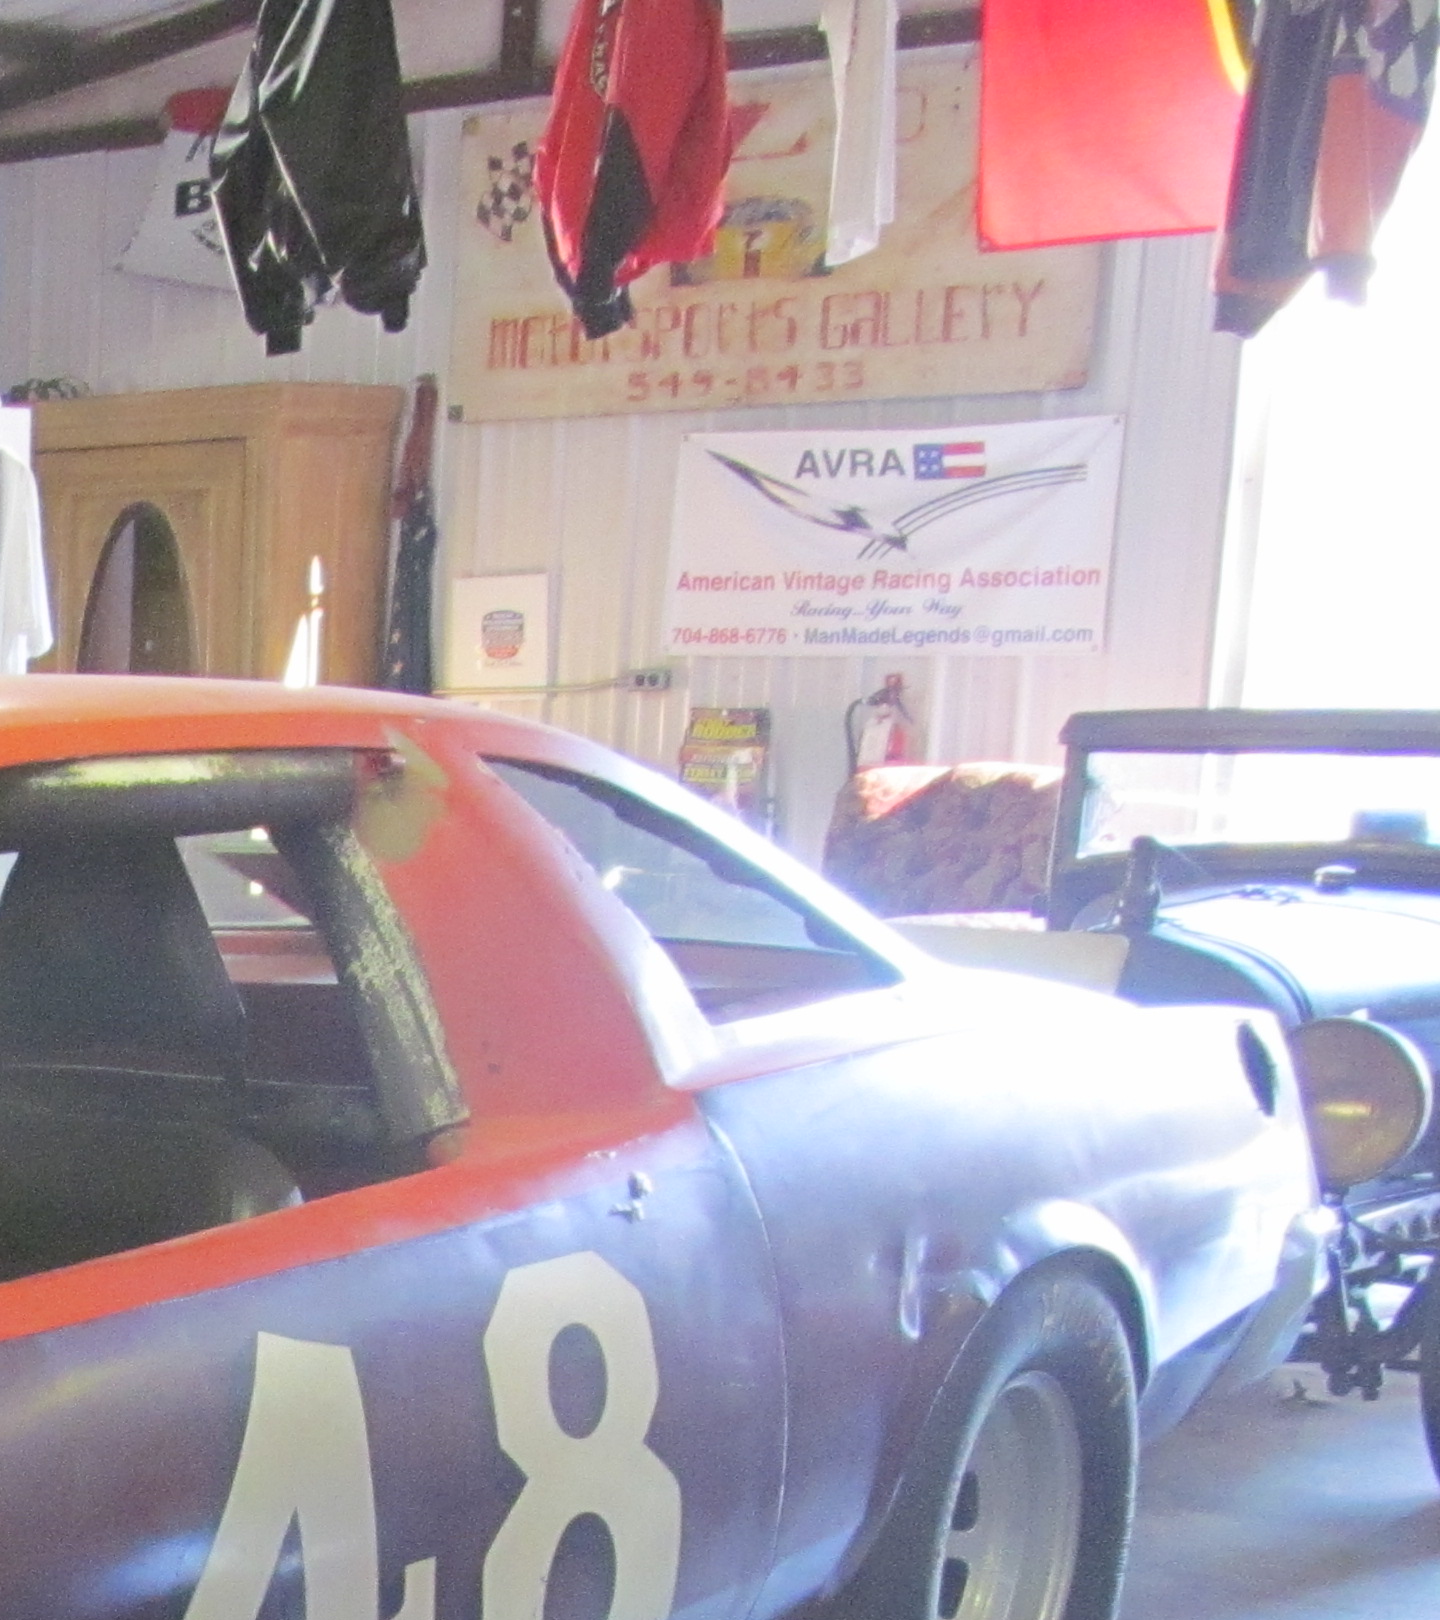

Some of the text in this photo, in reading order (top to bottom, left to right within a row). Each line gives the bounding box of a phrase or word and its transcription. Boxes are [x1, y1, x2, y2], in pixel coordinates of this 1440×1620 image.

[627, 360, 866, 401] 549-8433
[795, 449, 907, 480] AVRA
[676, 565, 1101, 596] American Vintage Racing Association
[922, 598, 963, 619] Way
[672, 624, 1094, 647] 704-868-6776 ManMadeLegends@gmail.com
